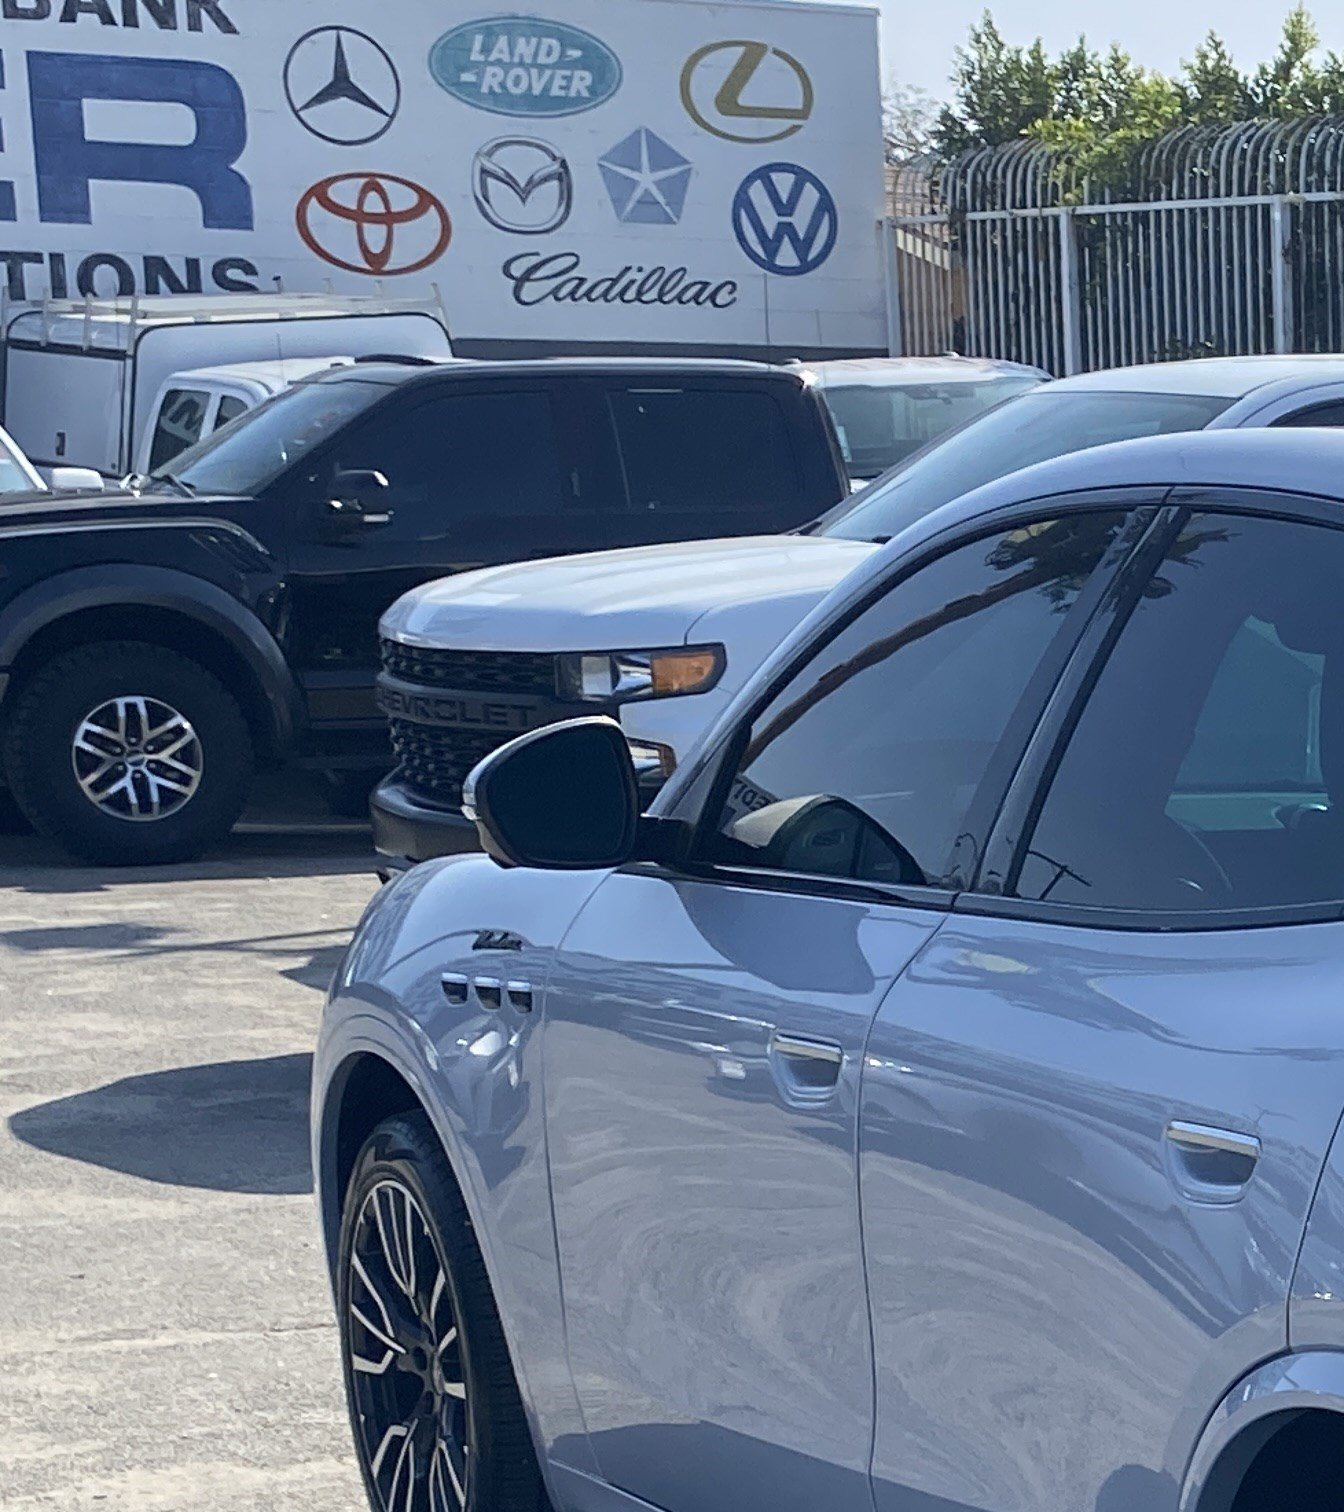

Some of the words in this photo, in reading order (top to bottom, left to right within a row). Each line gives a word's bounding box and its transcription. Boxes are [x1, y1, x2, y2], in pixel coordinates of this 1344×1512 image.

[469, 33, 562, 65] LAND
[480, 65, 594, 98] ROVER
[502, 251, 738, 308] Cadillac
